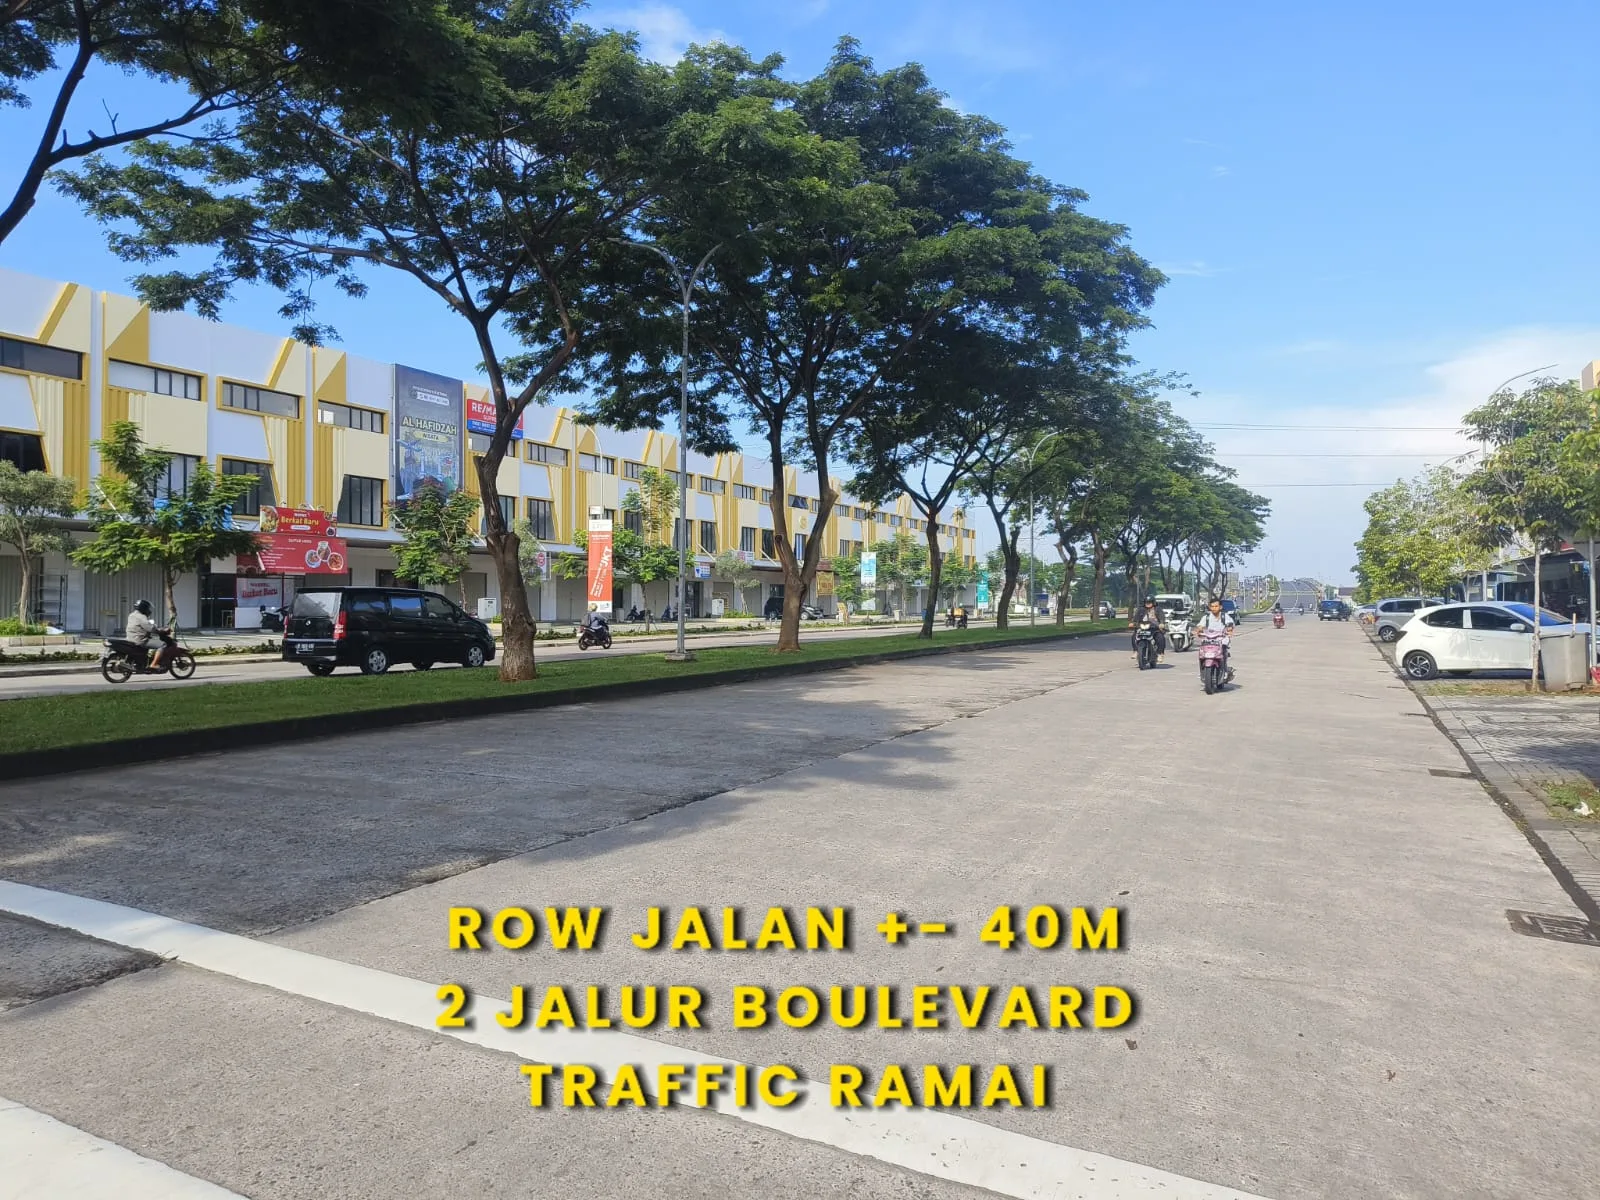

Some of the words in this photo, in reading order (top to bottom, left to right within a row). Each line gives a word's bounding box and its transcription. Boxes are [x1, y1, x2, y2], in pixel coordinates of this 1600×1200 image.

[471, 402, 496, 416] RE/MA
[402, 416, 414, 427] AL
[415, 418, 457, 435] HAFIDZAH
[281, 516, 303, 525] Berkat
[303, 517, 319, 525] Baru
